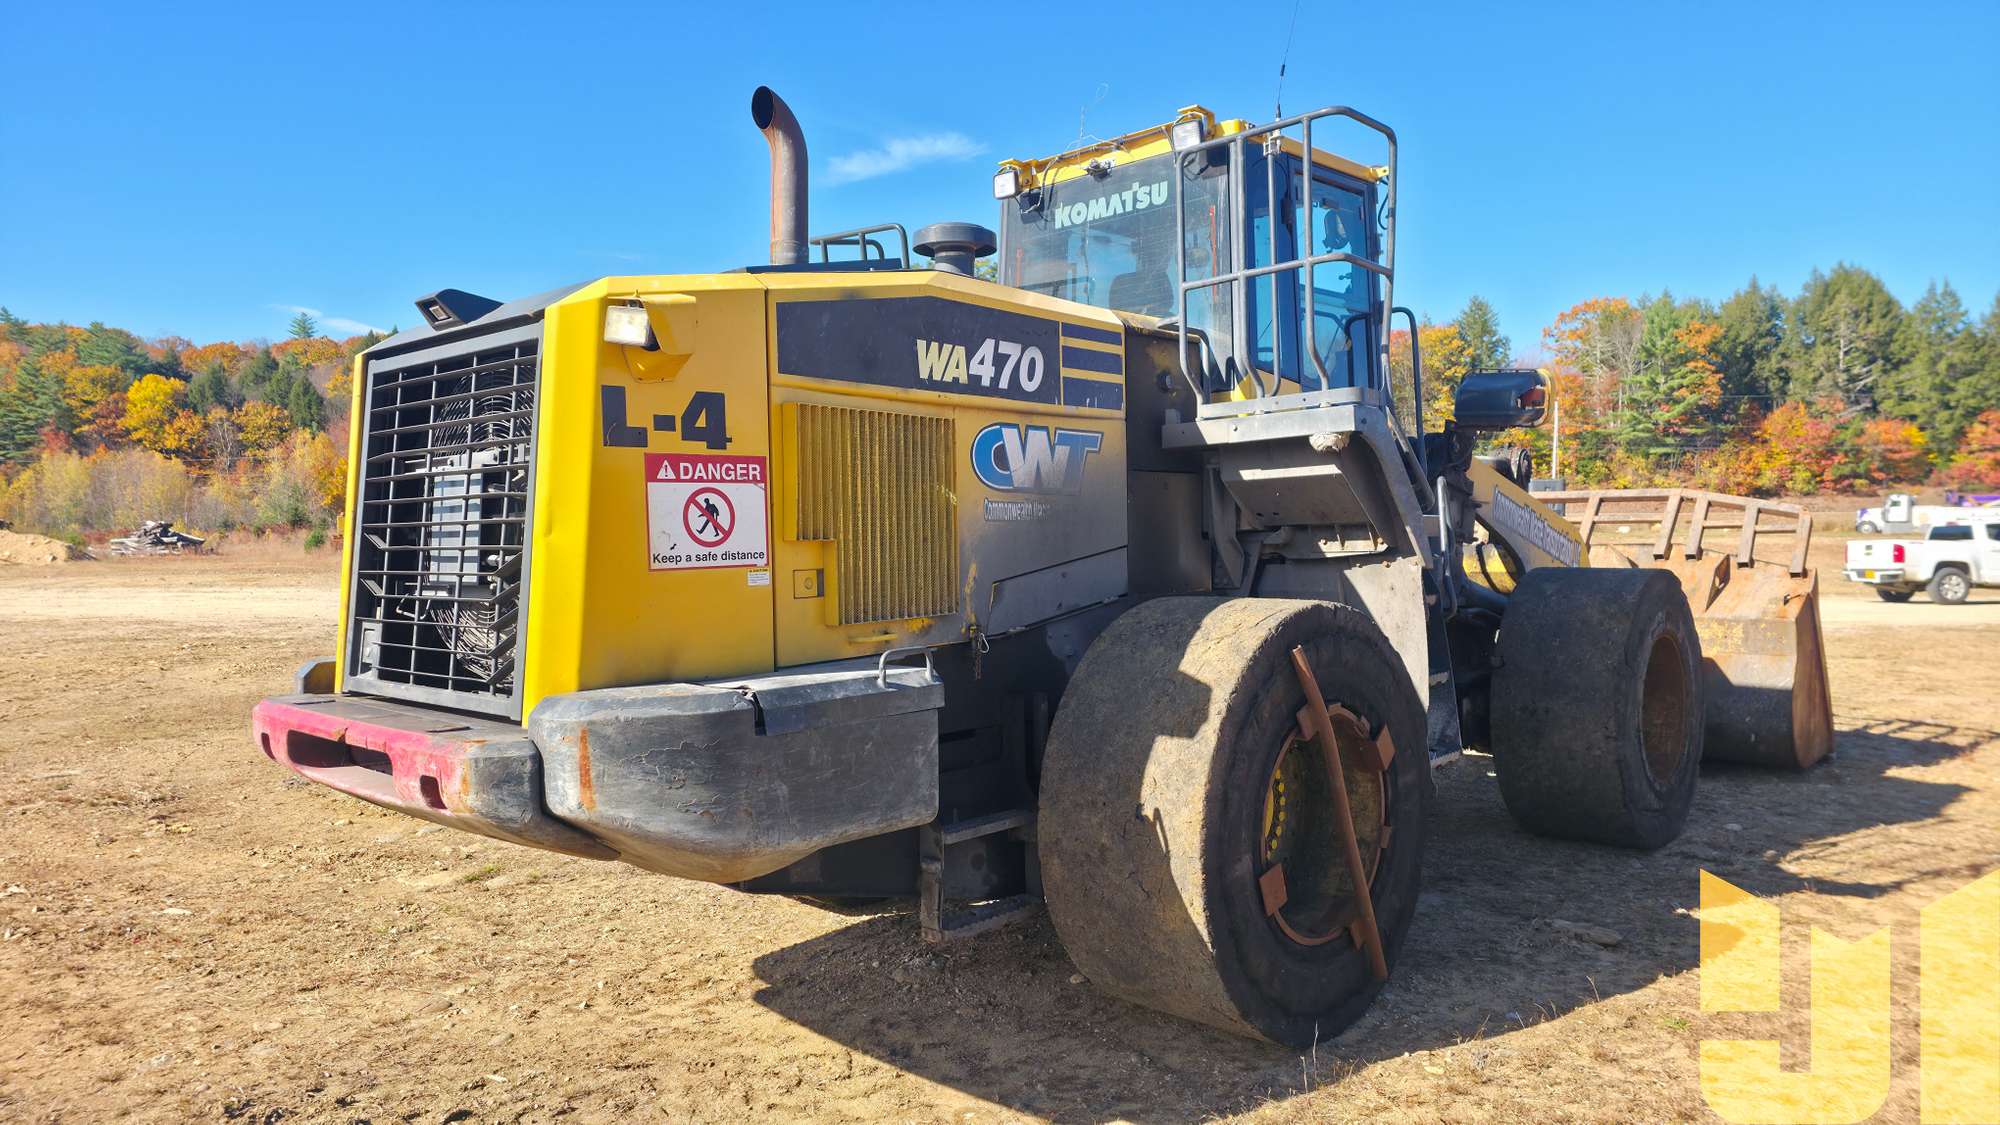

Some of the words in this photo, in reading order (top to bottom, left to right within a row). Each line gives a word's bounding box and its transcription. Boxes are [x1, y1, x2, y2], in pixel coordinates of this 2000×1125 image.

[1055, 181, 1168, 229] KOMATSU
[916, 338, 1044, 392] WA470
[601, 384, 732, 450] L-4
[679, 462, 761, 481] DANGER
[970, 421, 1104, 495] CWT
[652, 553, 682, 565] Keep
[685, 554, 692, 562] a
[695, 552, 718, 562] safe
[721, 550, 765, 561] distance
